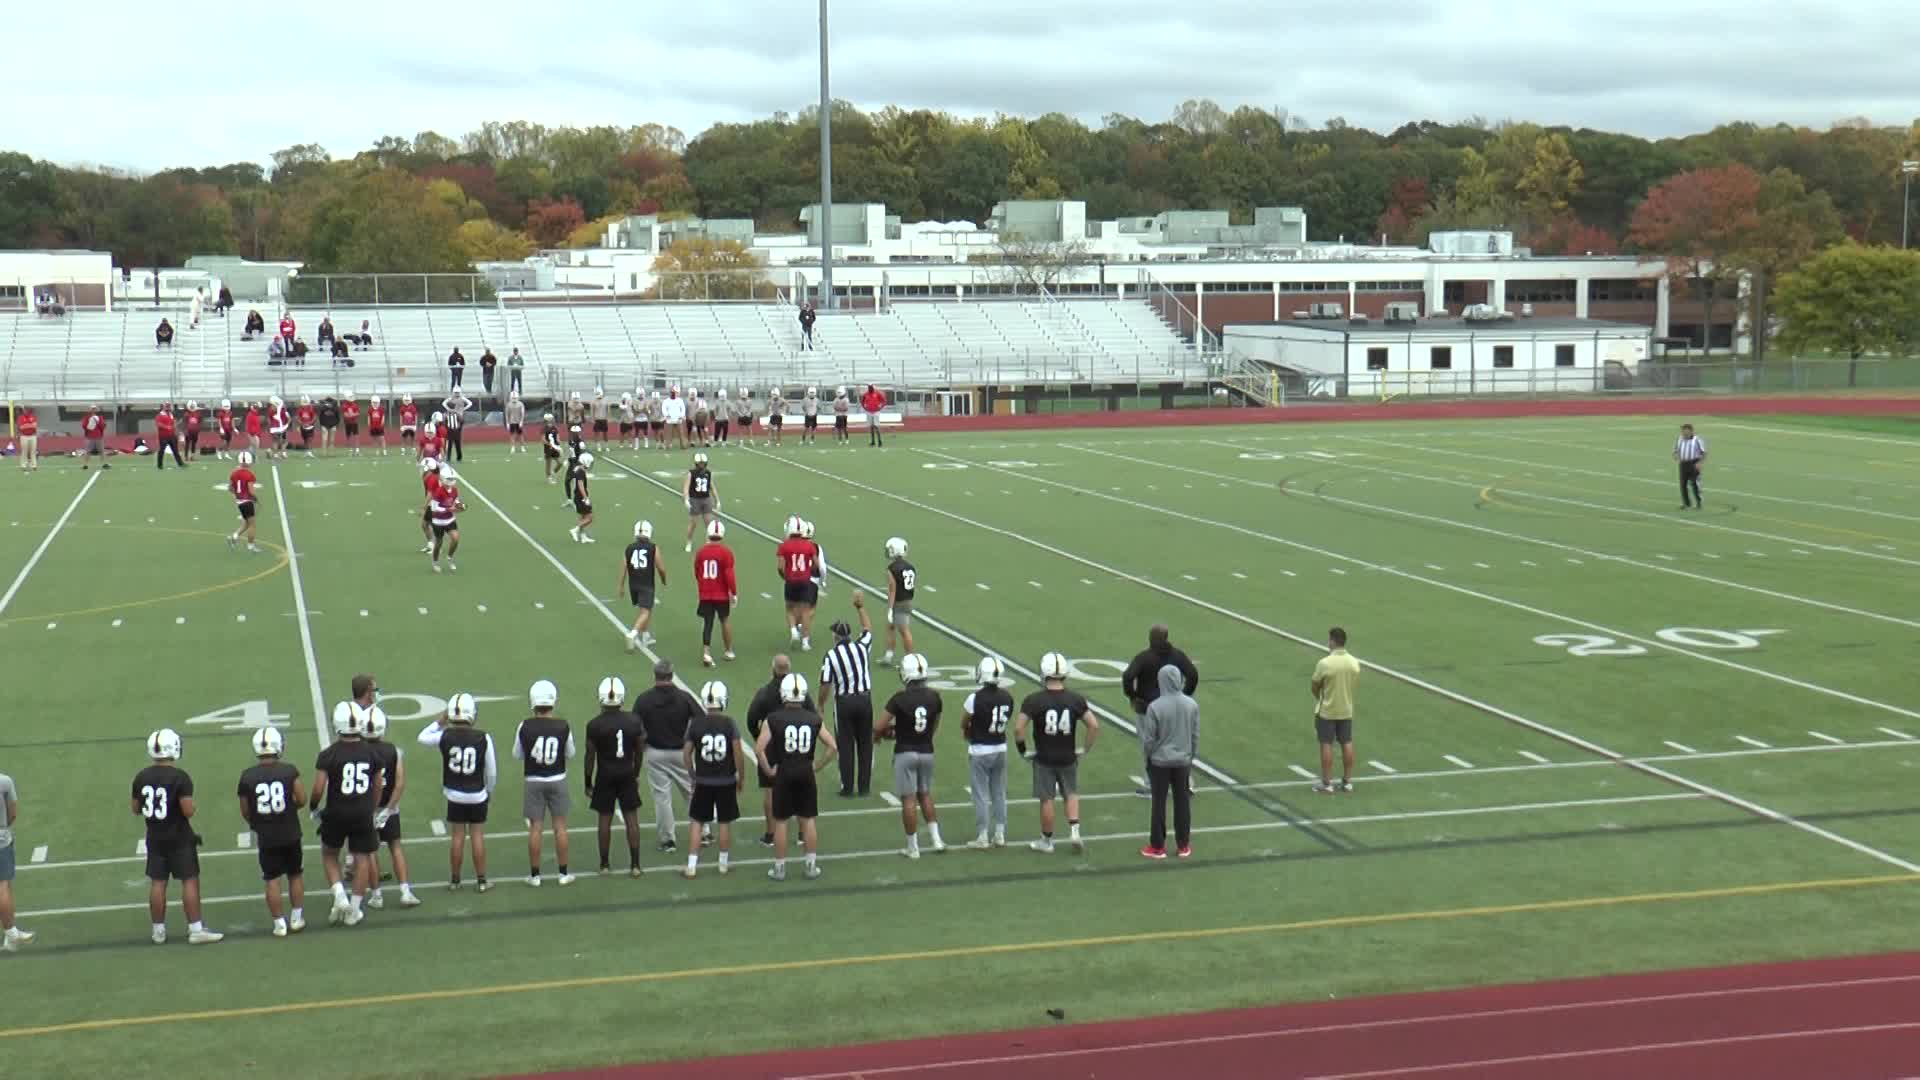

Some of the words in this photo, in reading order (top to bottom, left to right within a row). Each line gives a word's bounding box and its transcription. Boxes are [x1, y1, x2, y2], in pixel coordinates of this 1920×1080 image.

[630, 548, 648, 569] 45
[703, 559, 718, 580] 10
[791, 553, 806, 572] 14
[914, 706, 928, 732] 6
[988, 705, 1010, 733] 15
[1045, 709, 1071, 734] 84
[530, 735, 559, 765] 40
[615, 729, 625, 758] 1
[700, 734, 727, 762] 29
[784, 724, 812, 754] 80
[448, 746, 477, 775] 20
[340, 762, 370, 795] 85
[141, 785, 168, 820] 33
[255, 781, 286, 814] 28
